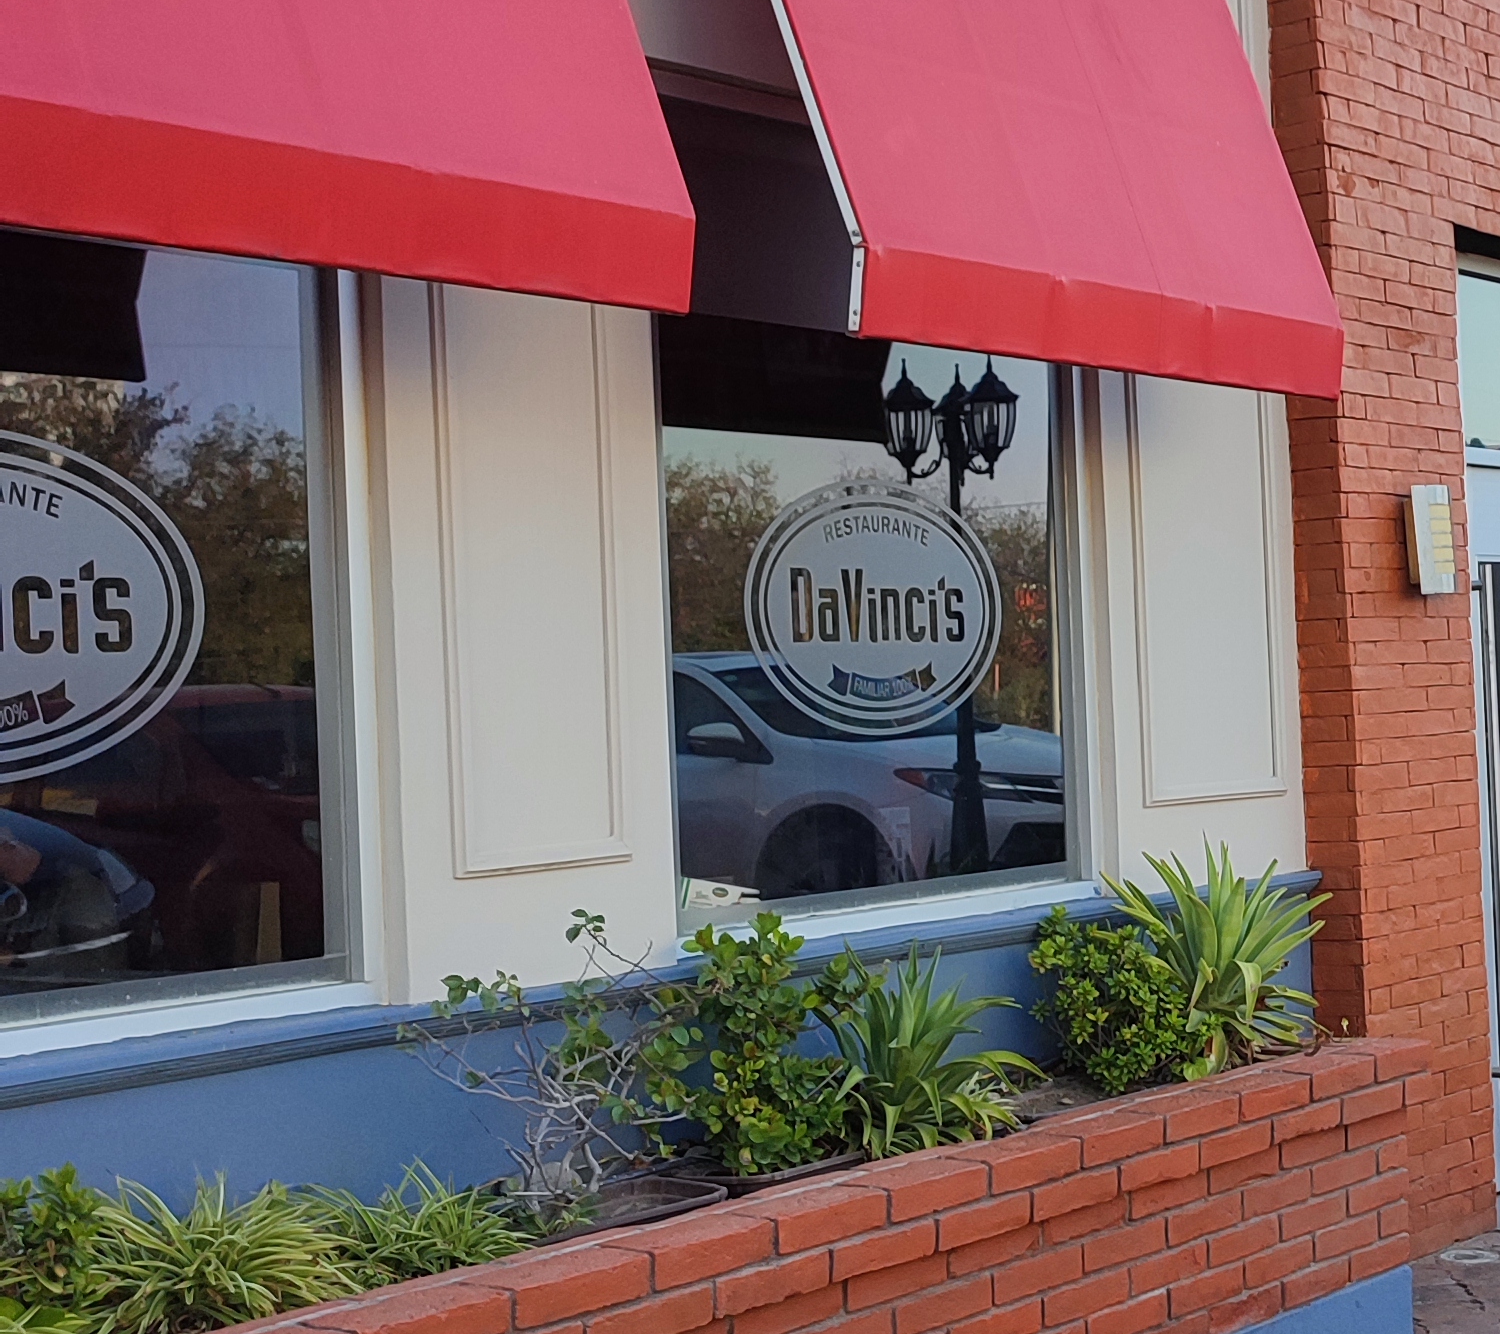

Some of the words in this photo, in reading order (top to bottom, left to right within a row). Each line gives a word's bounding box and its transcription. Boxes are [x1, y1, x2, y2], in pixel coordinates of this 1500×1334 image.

[822, 516, 930, 547] RESTAURANTE
[0, 559, 132, 654] ci's
[789, 567, 965, 643] DaVinci's
[854, 677, 890, 697] FAMILIAR
